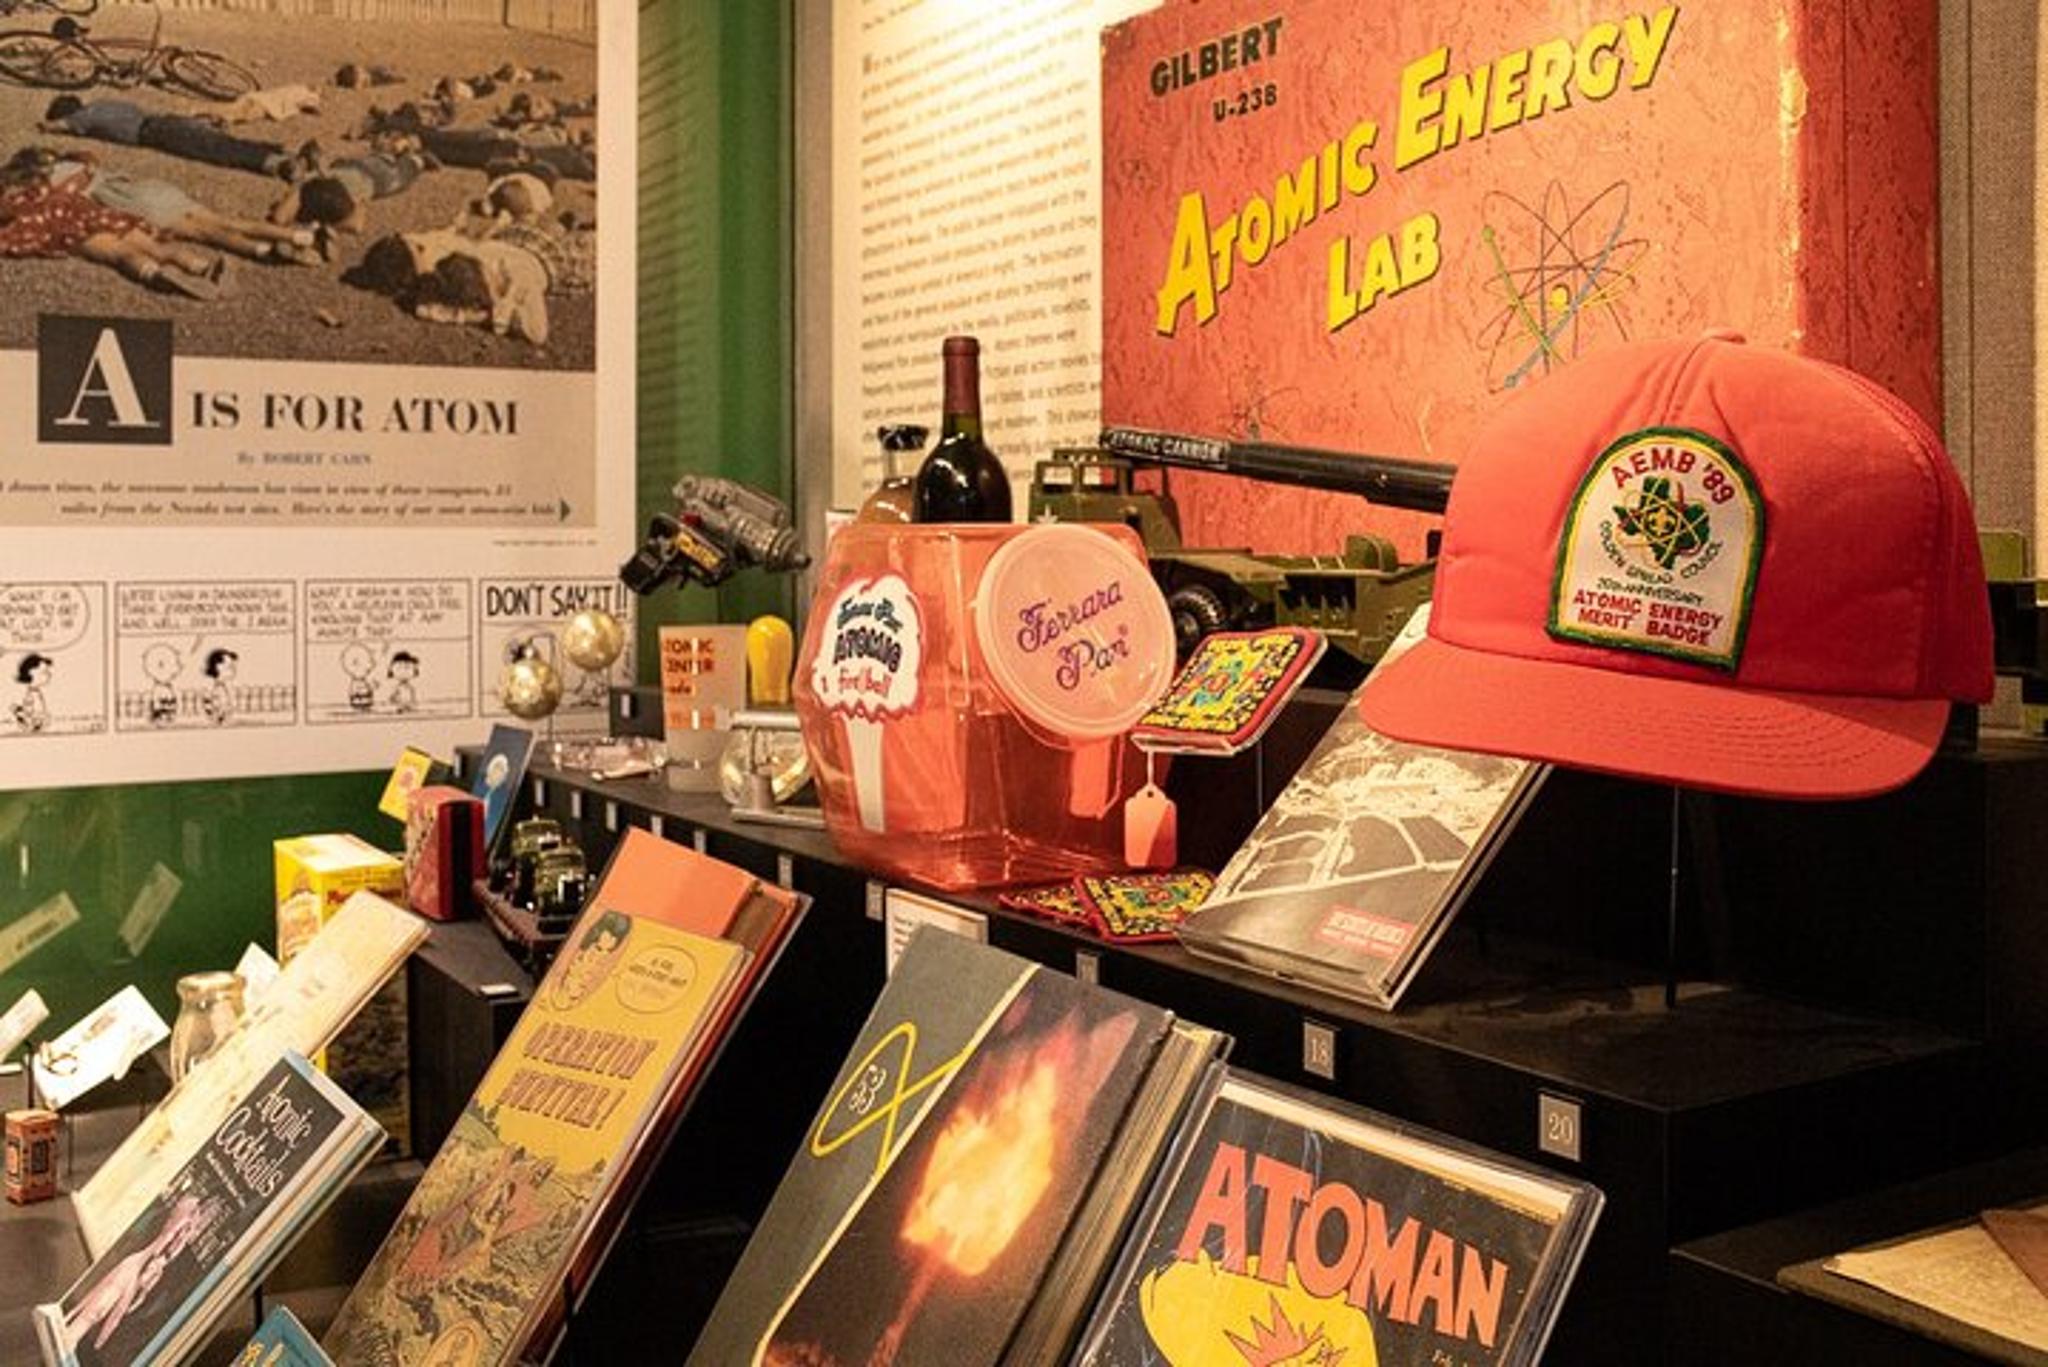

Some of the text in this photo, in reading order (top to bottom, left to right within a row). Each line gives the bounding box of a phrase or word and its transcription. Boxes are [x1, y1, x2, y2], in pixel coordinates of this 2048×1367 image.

[1150, 16, 1283, 97] GILBERT
[1213, 83, 1277, 122] U-238
[1156, 5, 1680, 337] ATOMIC ENERGY
[1329, 210, 1443, 333] LAB
[55, 328, 520, 436] A IS FOR ATOM
[263, 453, 323, 465] ROBERT
[1611, 447, 1736, 505] AEMB '89
[486, 583, 544, 617] DON'T
[550, 585, 588, 617] SAY
[1016, 581, 1124, 652] Ferrara
[1574, 588, 1724, 630] ATOMIC ENERGY
[1578, 607, 1712, 647] MERIT BADGE
[255, 1073, 315, 1150] Atomic
[1548, 1110, 1574, 1145] 20
[216, 1105, 291, 1198] Cocktails
[1176, 1140, 1510, 1349] ATOMAN
